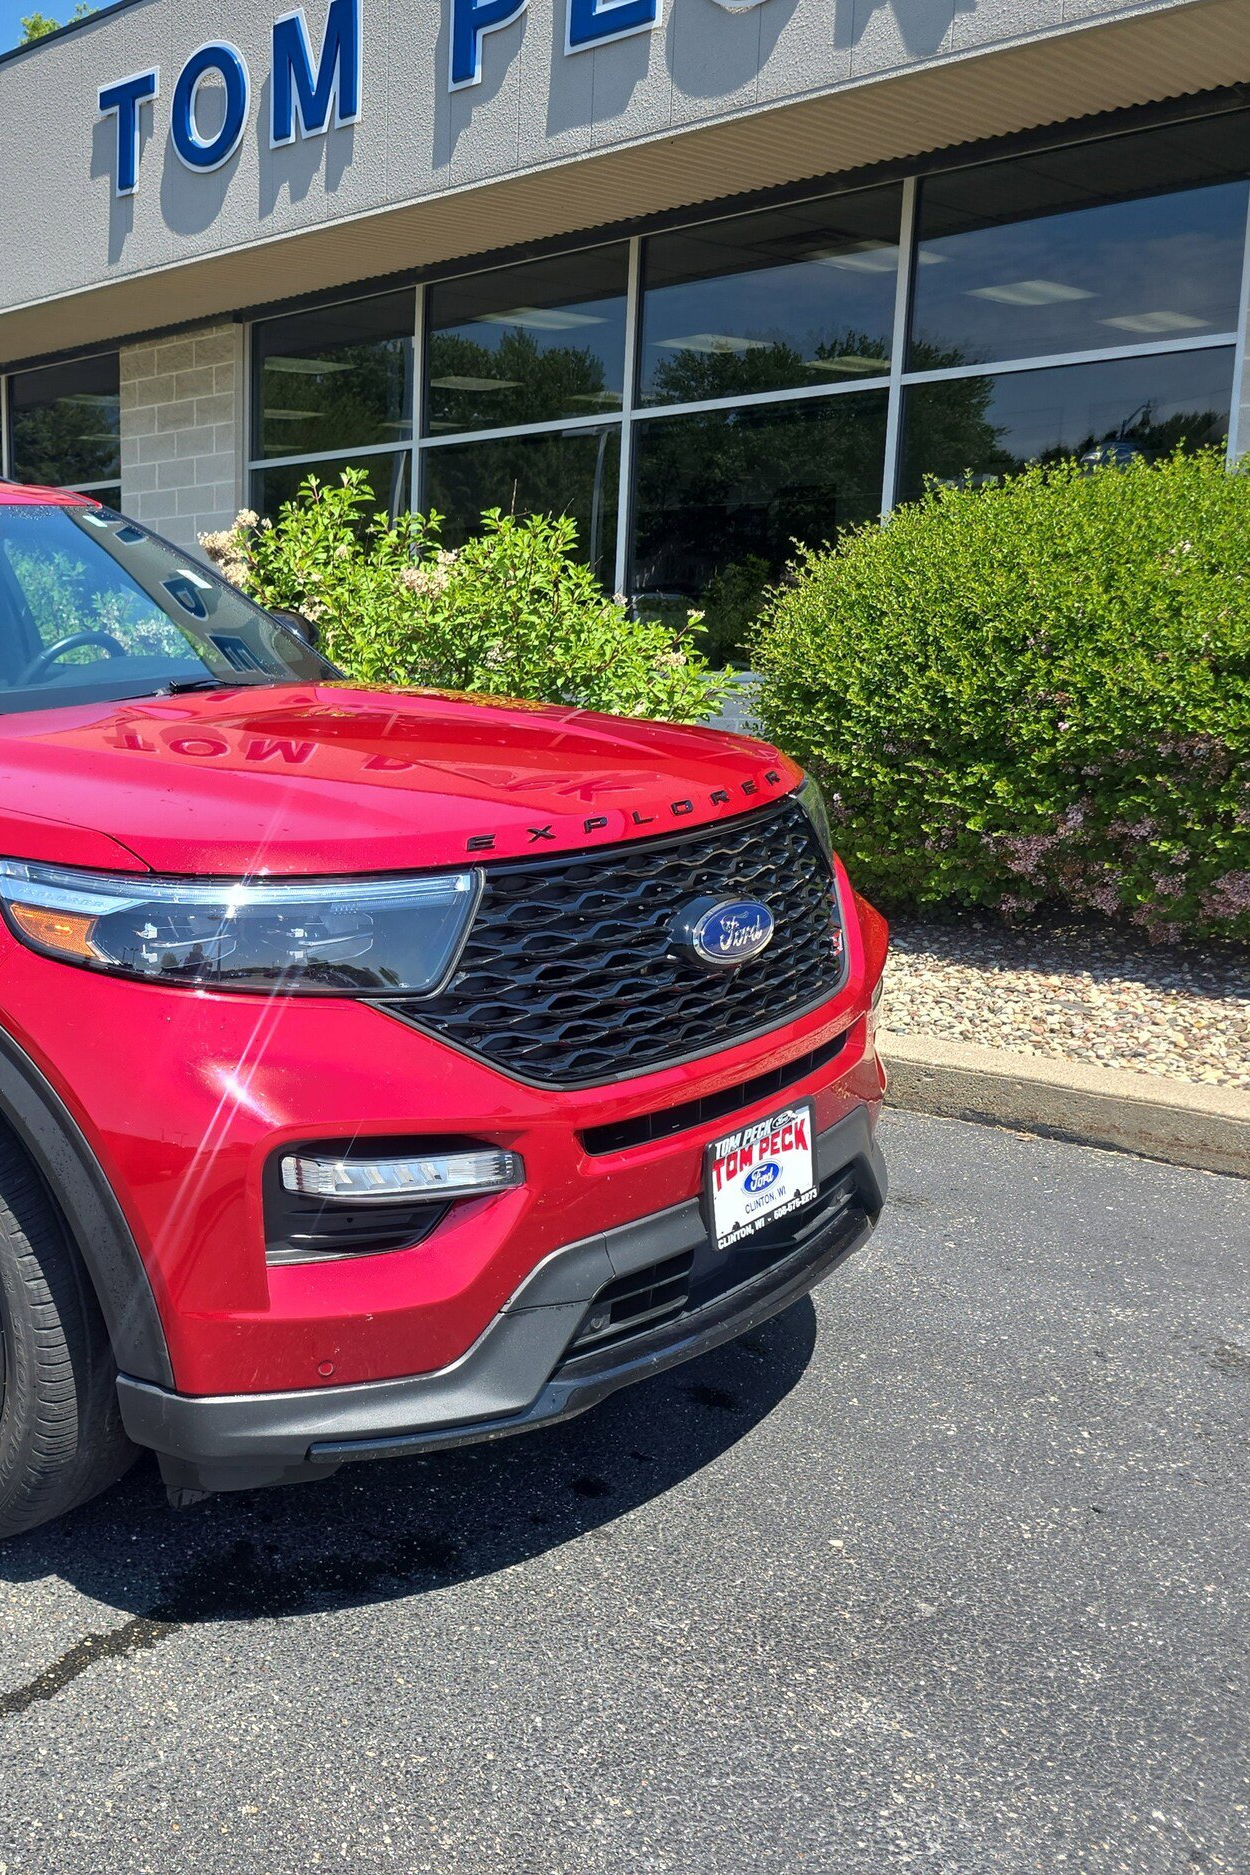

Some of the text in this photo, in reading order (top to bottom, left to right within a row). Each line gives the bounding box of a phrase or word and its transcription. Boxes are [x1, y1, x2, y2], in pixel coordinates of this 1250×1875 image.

[98, 0, 362, 197] TOM
[466, 770, 781, 851] EXPLORER
[719, 911, 763, 951] Ford
[712, 1144, 753, 1192] TOM
[759, 1118, 809, 1160] PECK
[715, 1132, 742, 1160] TOM
[743, 1118, 774, 1147] PECK
[750, 1166, 774, 1191] Ford
[777, 1185, 786, 1197] WI
[717, 1224, 754, 1250] CLINTON,
[754, 1217, 765, 1231] WI
